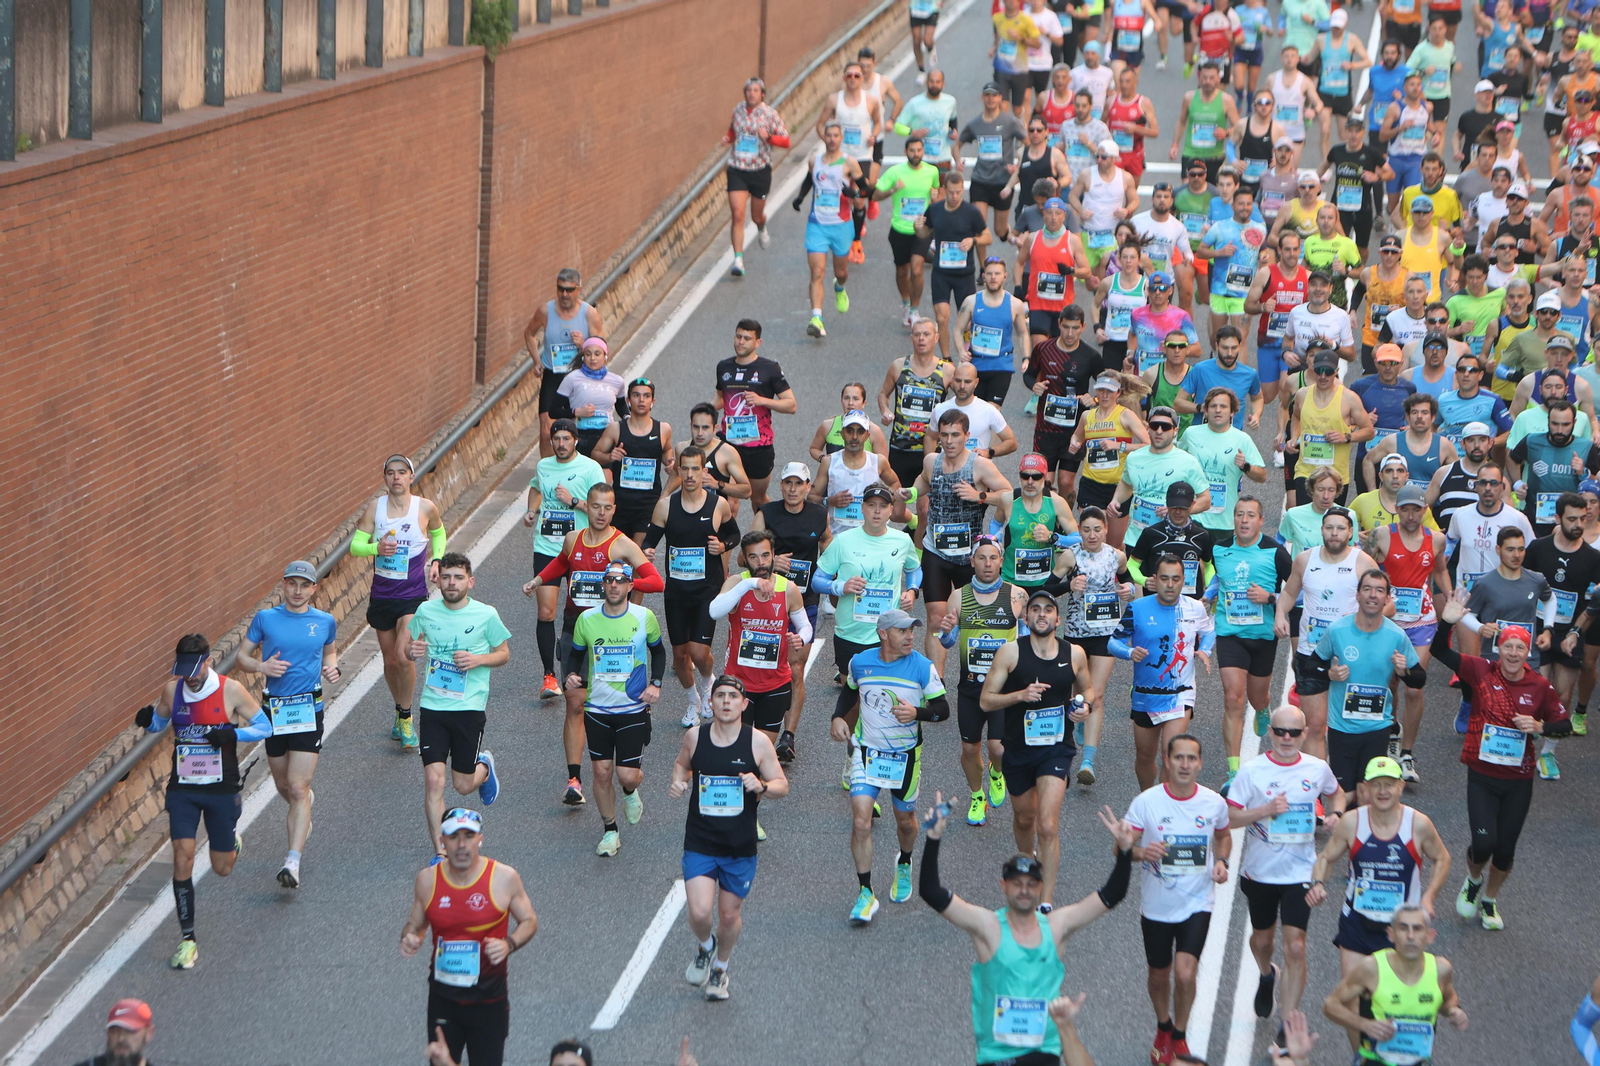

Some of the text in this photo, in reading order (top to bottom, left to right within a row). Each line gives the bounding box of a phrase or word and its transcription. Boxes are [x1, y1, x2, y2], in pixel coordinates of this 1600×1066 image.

[1089, 421, 1114, 430] LAURA
[1473, 539, 1492, 549] 100
[285, 698, 308, 706] ZURICH
[1038, 710, 1061, 719] ZURICH
